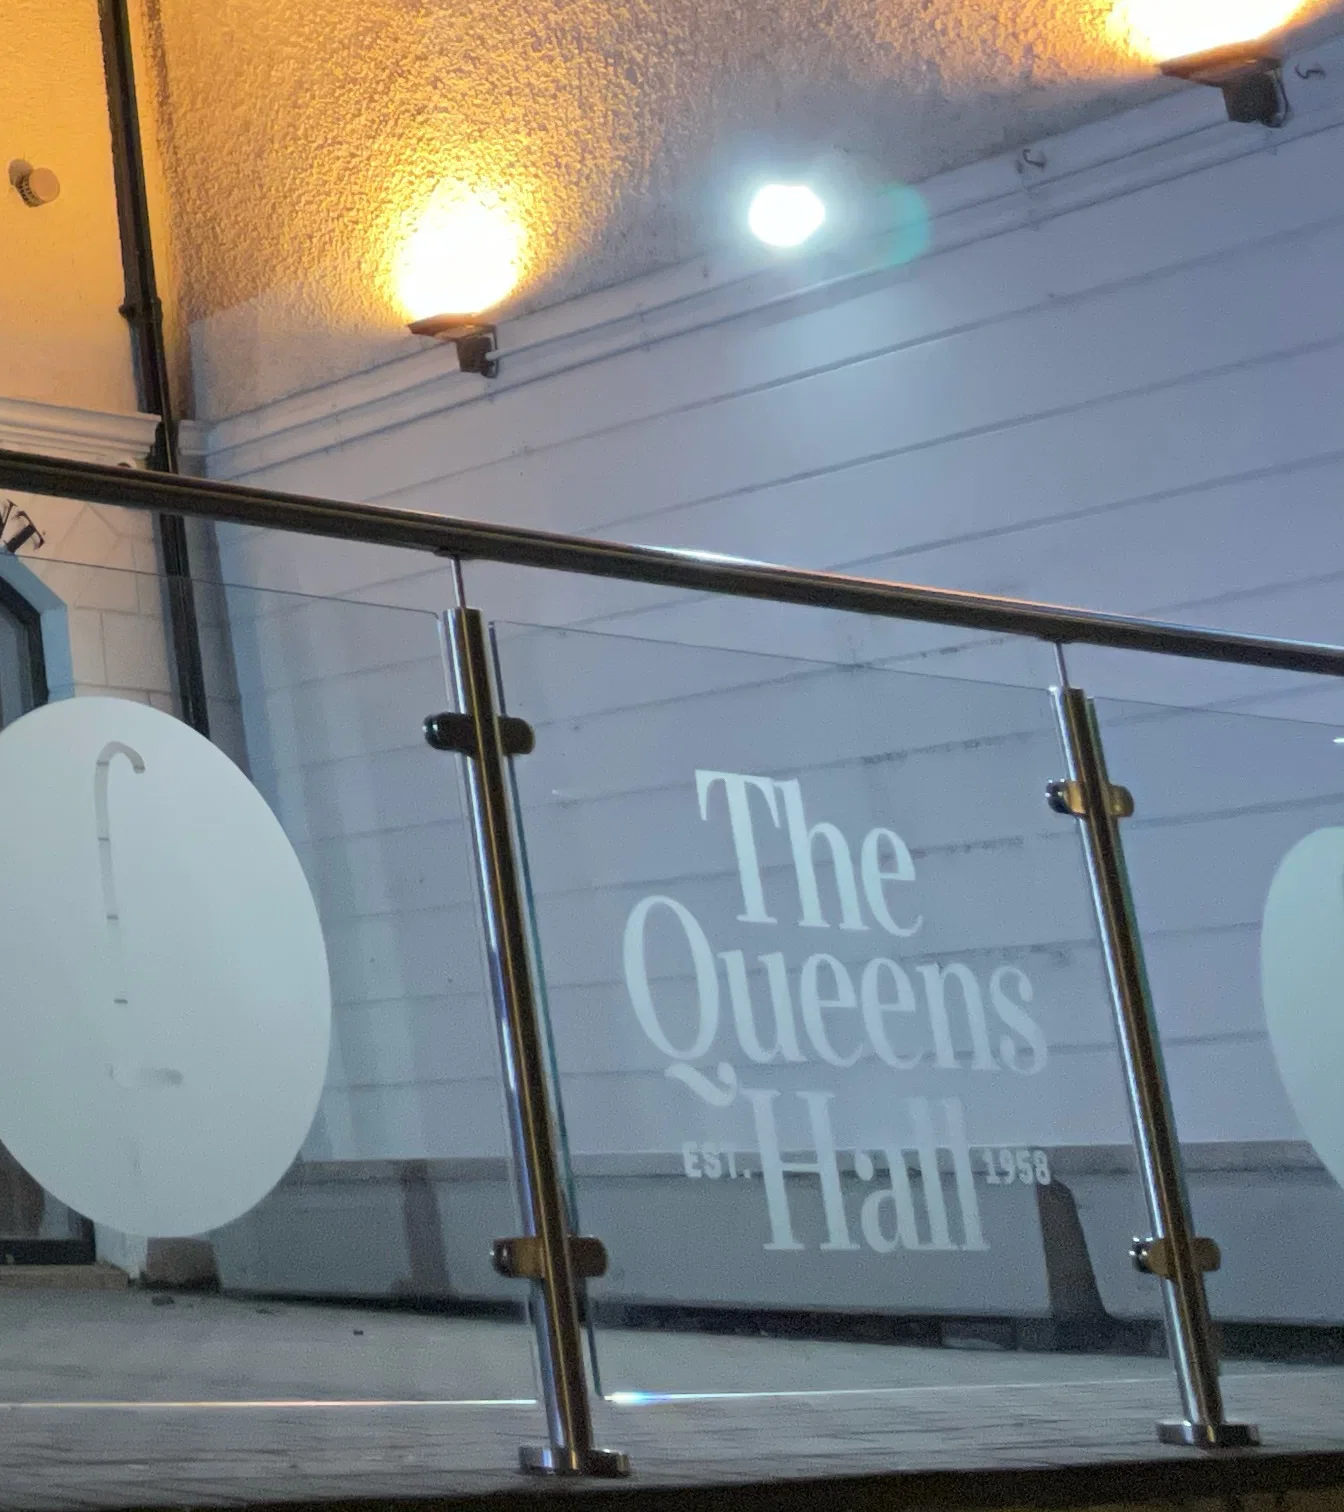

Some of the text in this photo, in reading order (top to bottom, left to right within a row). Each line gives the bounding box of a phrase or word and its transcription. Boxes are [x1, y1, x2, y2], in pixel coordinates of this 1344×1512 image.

[695, 769, 925, 937] The
[622, 894, 1048, 1107] Queens
[680, 1141, 754, 1179] EST.
[746, 1089, 992, 1252] Hall
[982, 1148, 1052, 1186] 1958
